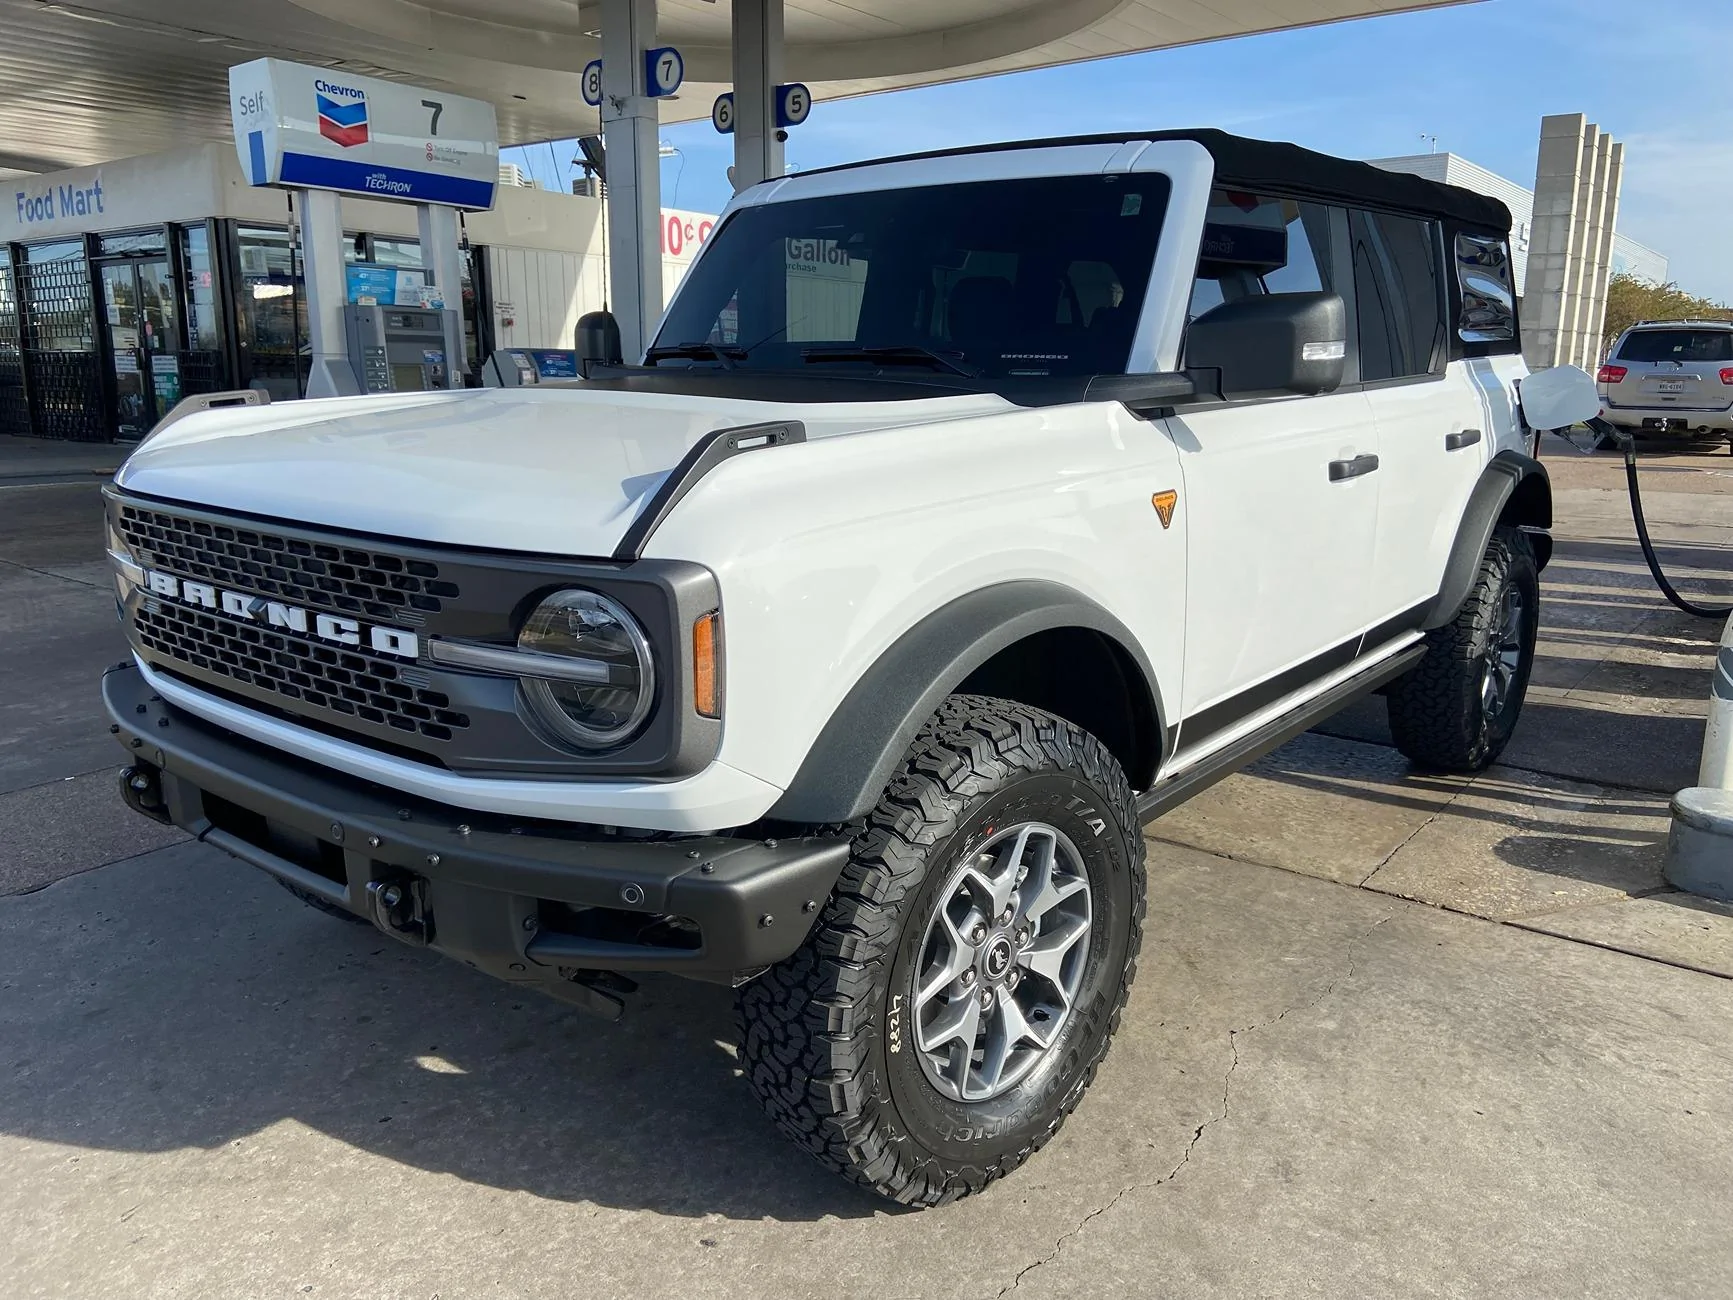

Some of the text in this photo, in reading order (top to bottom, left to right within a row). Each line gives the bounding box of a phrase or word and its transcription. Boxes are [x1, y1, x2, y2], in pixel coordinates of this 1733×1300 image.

[662, 60, 673, 81] 7
[315, 79, 365, 99] Chevron
[589, 73, 598, 93] 8
[240, 91, 264, 116] Self
[719, 105, 728, 123] 6
[791, 95, 802, 113] 5
[421, 100, 443, 135] 7
[365, 176, 412, 193] TECHRON
[16, 179, 104, 223] Food Mart
[787, 237, 850, 266] Gallon
[786, 262, 817, 273] rchase
[149, 570, 419, 658] BRONCO
[1065, 795, 1107, 837] T/A
